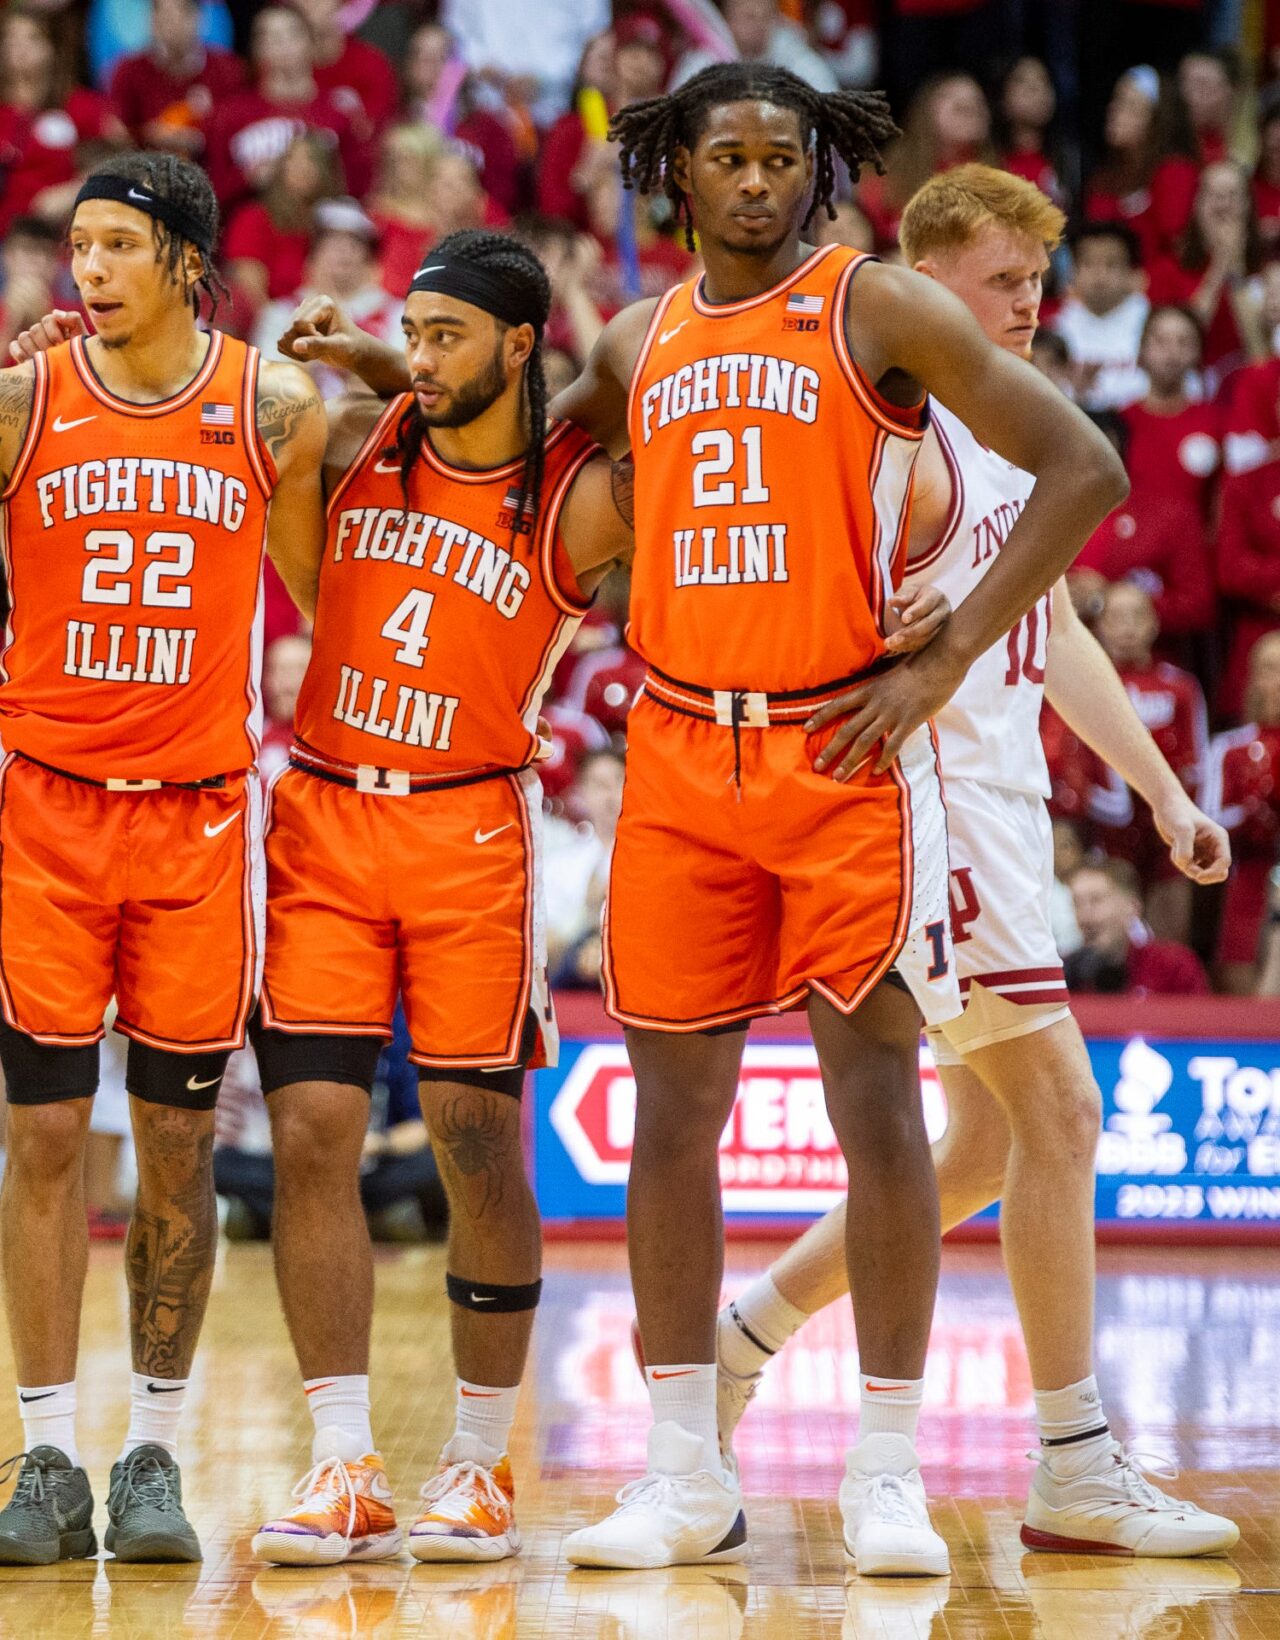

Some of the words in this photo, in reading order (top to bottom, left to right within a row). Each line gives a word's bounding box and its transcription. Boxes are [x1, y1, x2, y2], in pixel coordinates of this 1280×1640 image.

[641, 353, 820, 447] FIGHTING
[36, 457, 248, 533] FIGHTING
[691, 425, 769, 508] 21
[81, 529, 195, 609] 22
[334, 507, 531, 620] FIGHTING
[674, 523, 789, 588] ILLINI
[64, 619, 197, 685] ILLINI
[380, 587, 435, 669] 4
[333, 664, 460, 751] ILLINI
[925, 919, 949, 982] I
